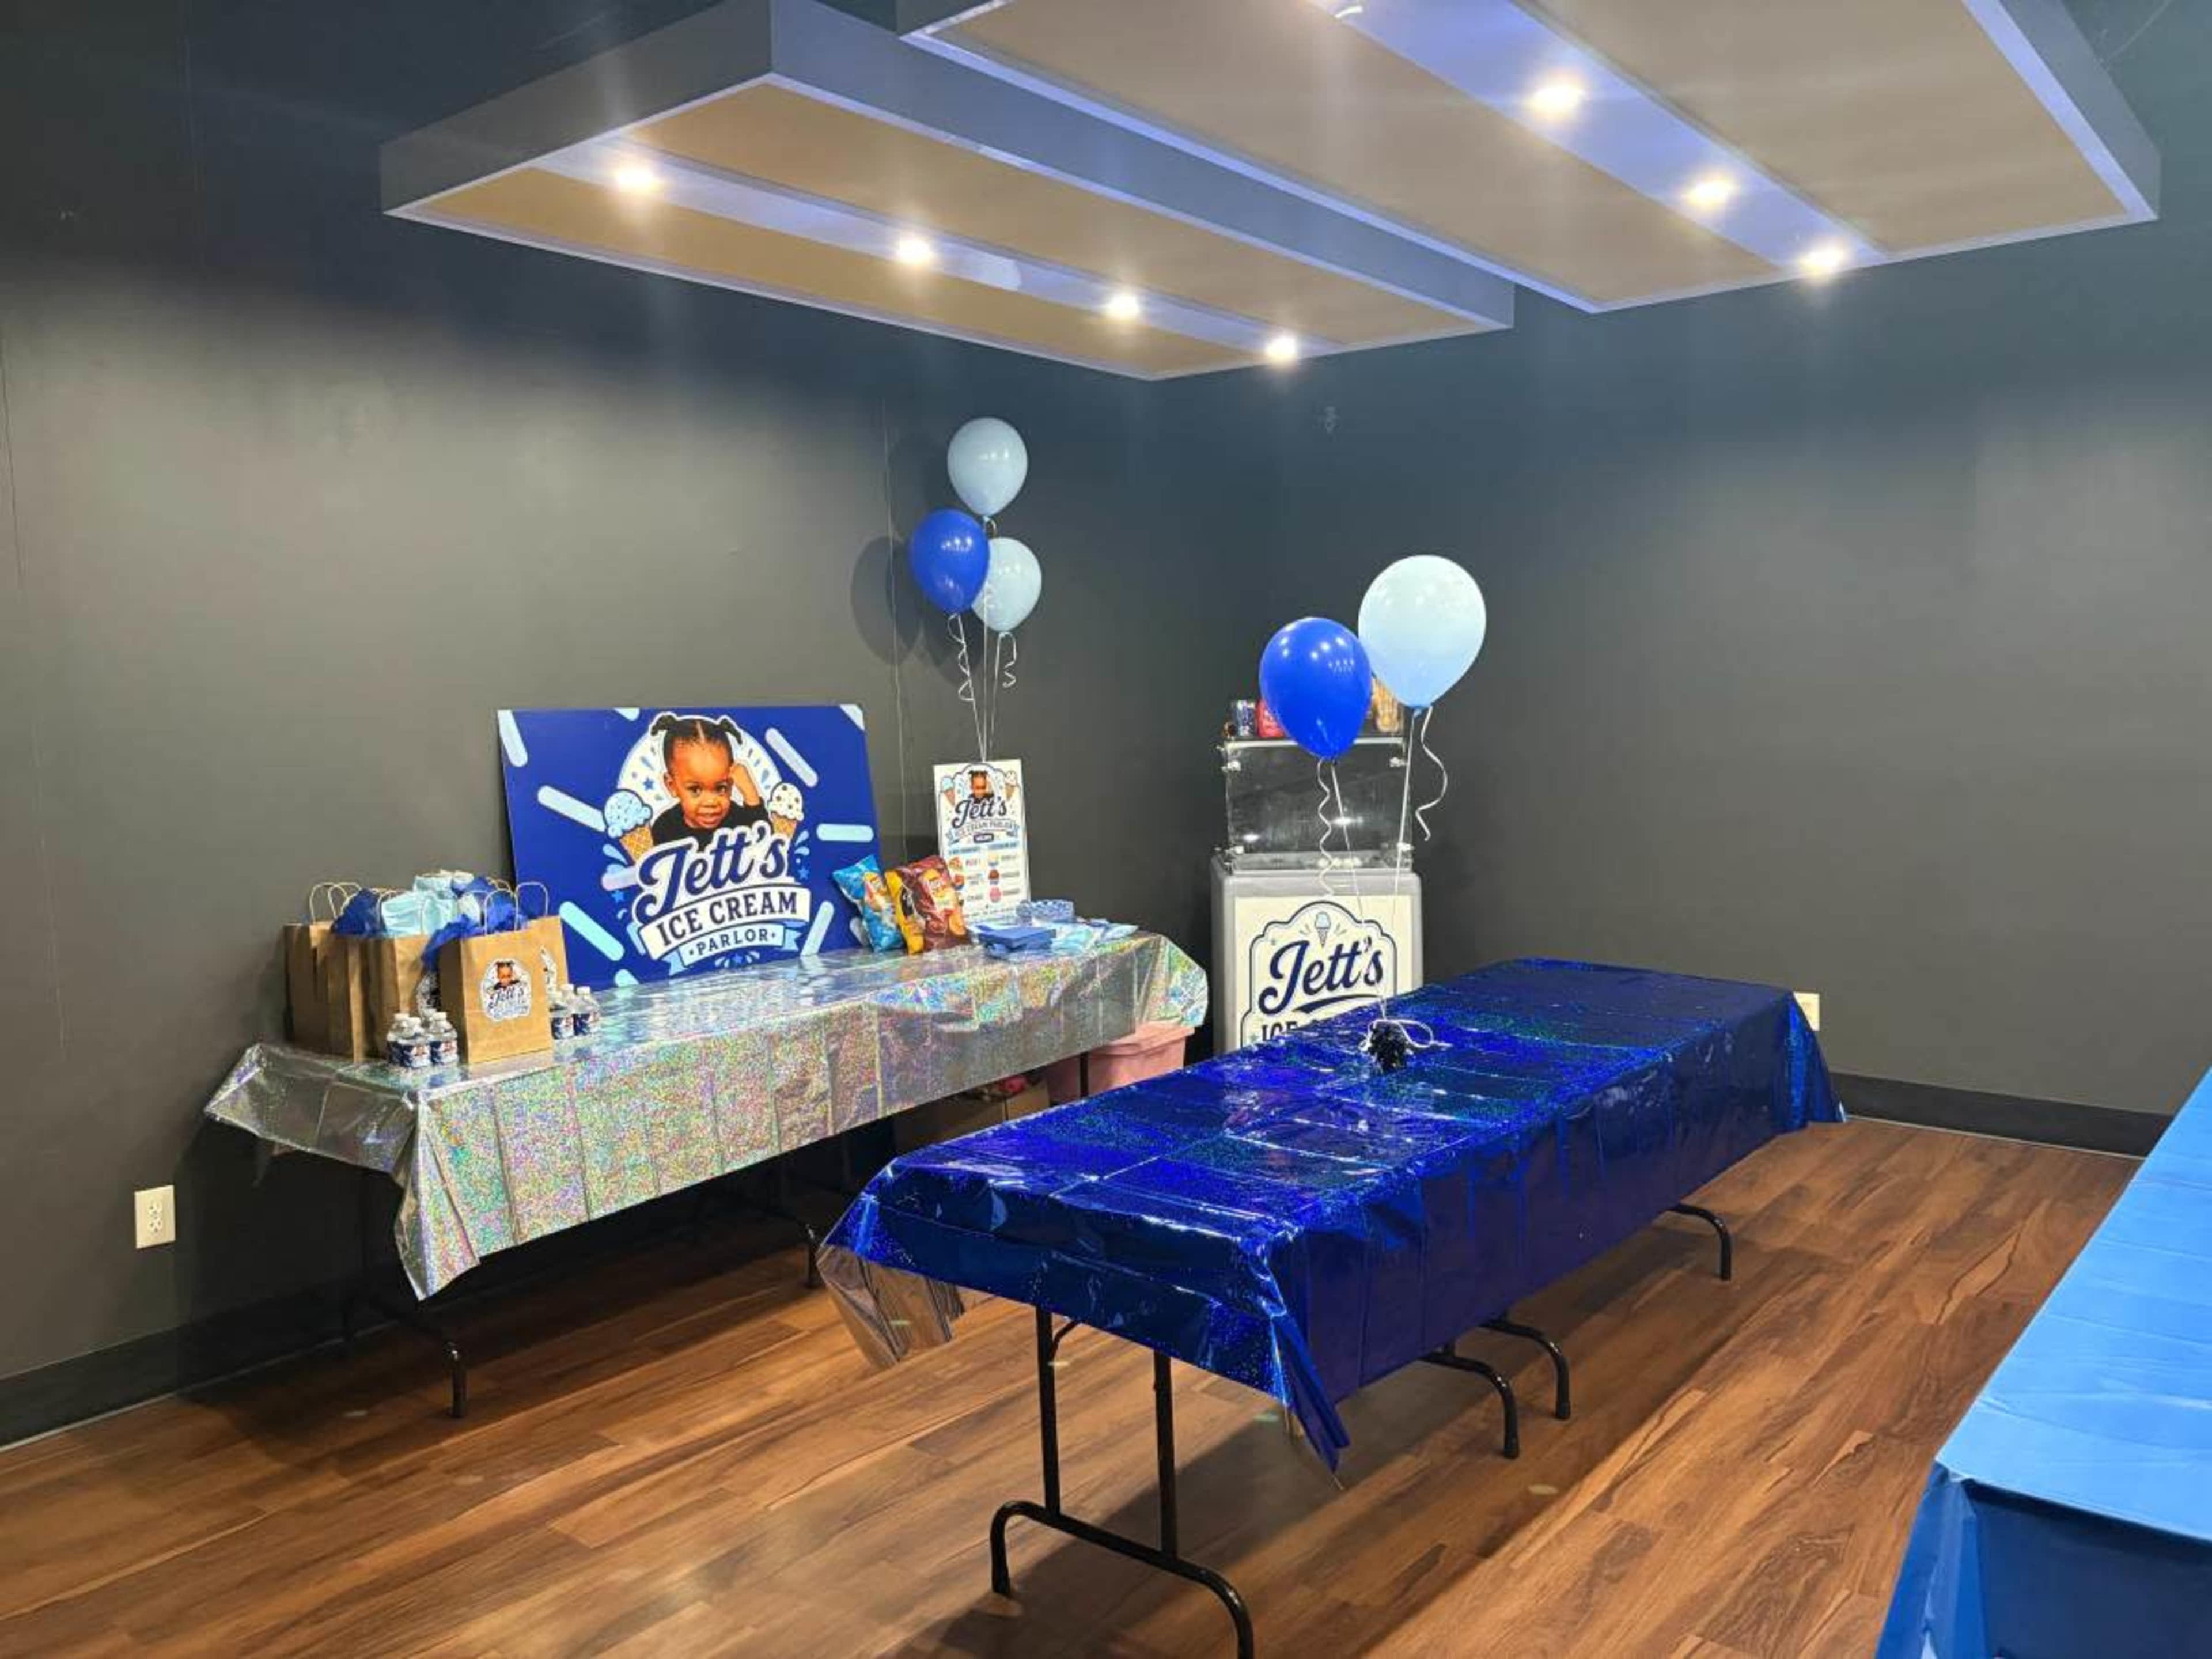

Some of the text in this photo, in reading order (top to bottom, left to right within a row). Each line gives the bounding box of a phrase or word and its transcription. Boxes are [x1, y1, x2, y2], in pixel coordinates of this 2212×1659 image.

[952, 796, 1007, 828] Jett's
[635, 825, 785, 924] Jett's
[656, 891, 797, 946] ICE CREAM
[696, 927, 768, 955] PARLOR
[1258, 936, 1383, 1015] Jett's
